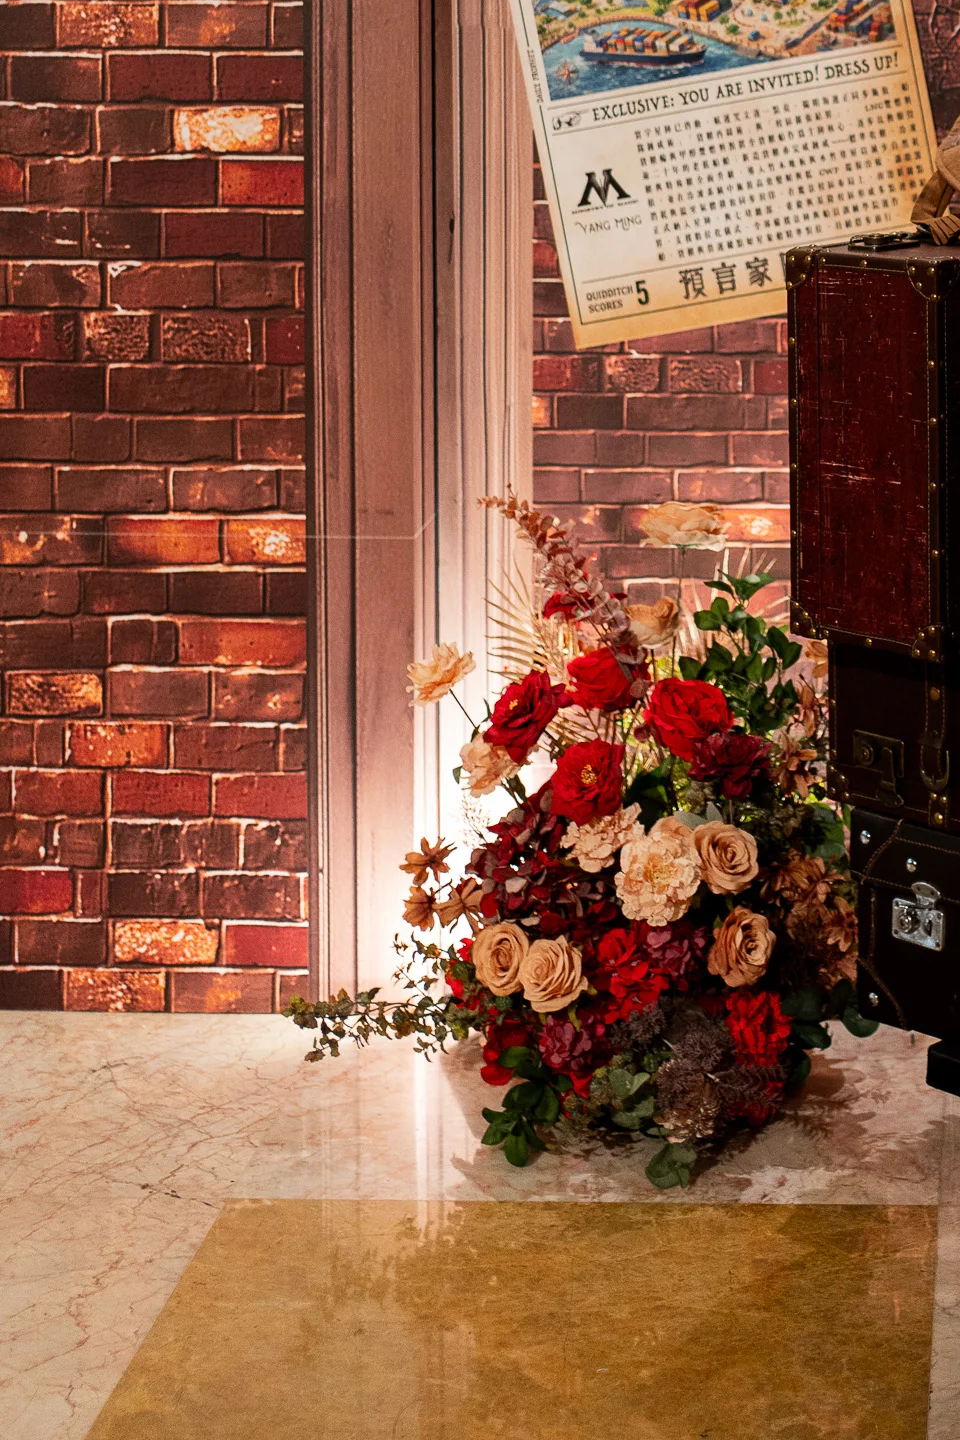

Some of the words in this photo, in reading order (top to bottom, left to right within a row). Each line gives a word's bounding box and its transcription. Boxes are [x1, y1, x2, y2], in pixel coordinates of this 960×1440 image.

[590, 93, 676, 123] EXCLUSIVE:
[677, 86, 711, 107] YOU
[714, 80, 744, 100] ARE
[747, 64, 822, 94] INVITED!
[822, 57, 870, 80] DRESS
[872, 50, 901, 71] UP!
[573, 215, 611, 236] YANG
[614, 213, 643, 233] MING
[676, 249, 789, 302] 預言家
[585, 284, 633, 302] QUIDDITCH
[634, 278, 650, 306] 5
[587, 298, 624, 314] SCORES
